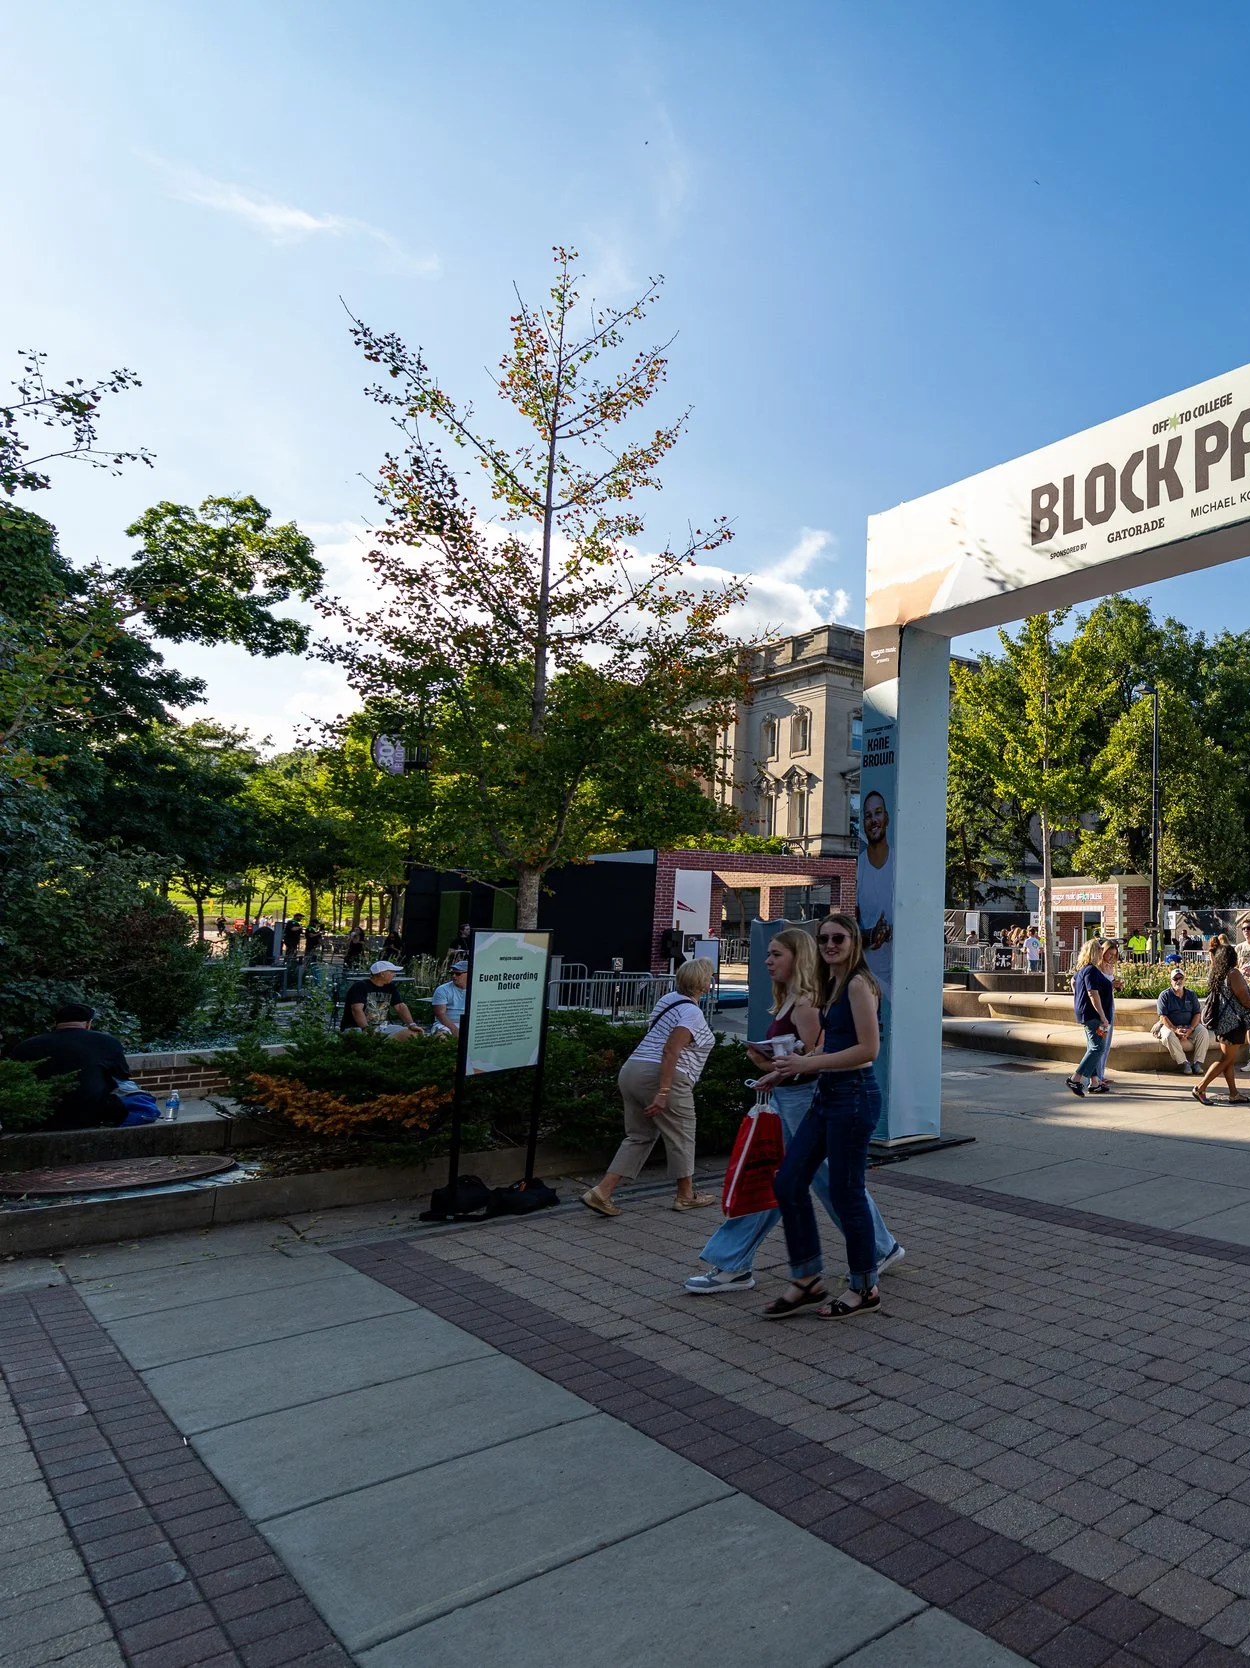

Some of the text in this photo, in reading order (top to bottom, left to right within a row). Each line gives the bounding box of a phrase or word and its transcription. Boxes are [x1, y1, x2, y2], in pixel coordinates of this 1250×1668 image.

[1152, 392, 1233, 435] OFF TO COLLEGE
[1031, 434, 1184, 546] BLOCK
[1190, 496, 1237, 519] MICHAEL
[1107, 517, 1166, 543] GATORADE
[1050, 542, 1088, 560] SPONSORED BY
[868, 736, 890, 752] KANE
[863, 751, 895, 768] BROWN
[479, 971, 539, 982] Event Recording
[497, 982, 521, 991] Notice
